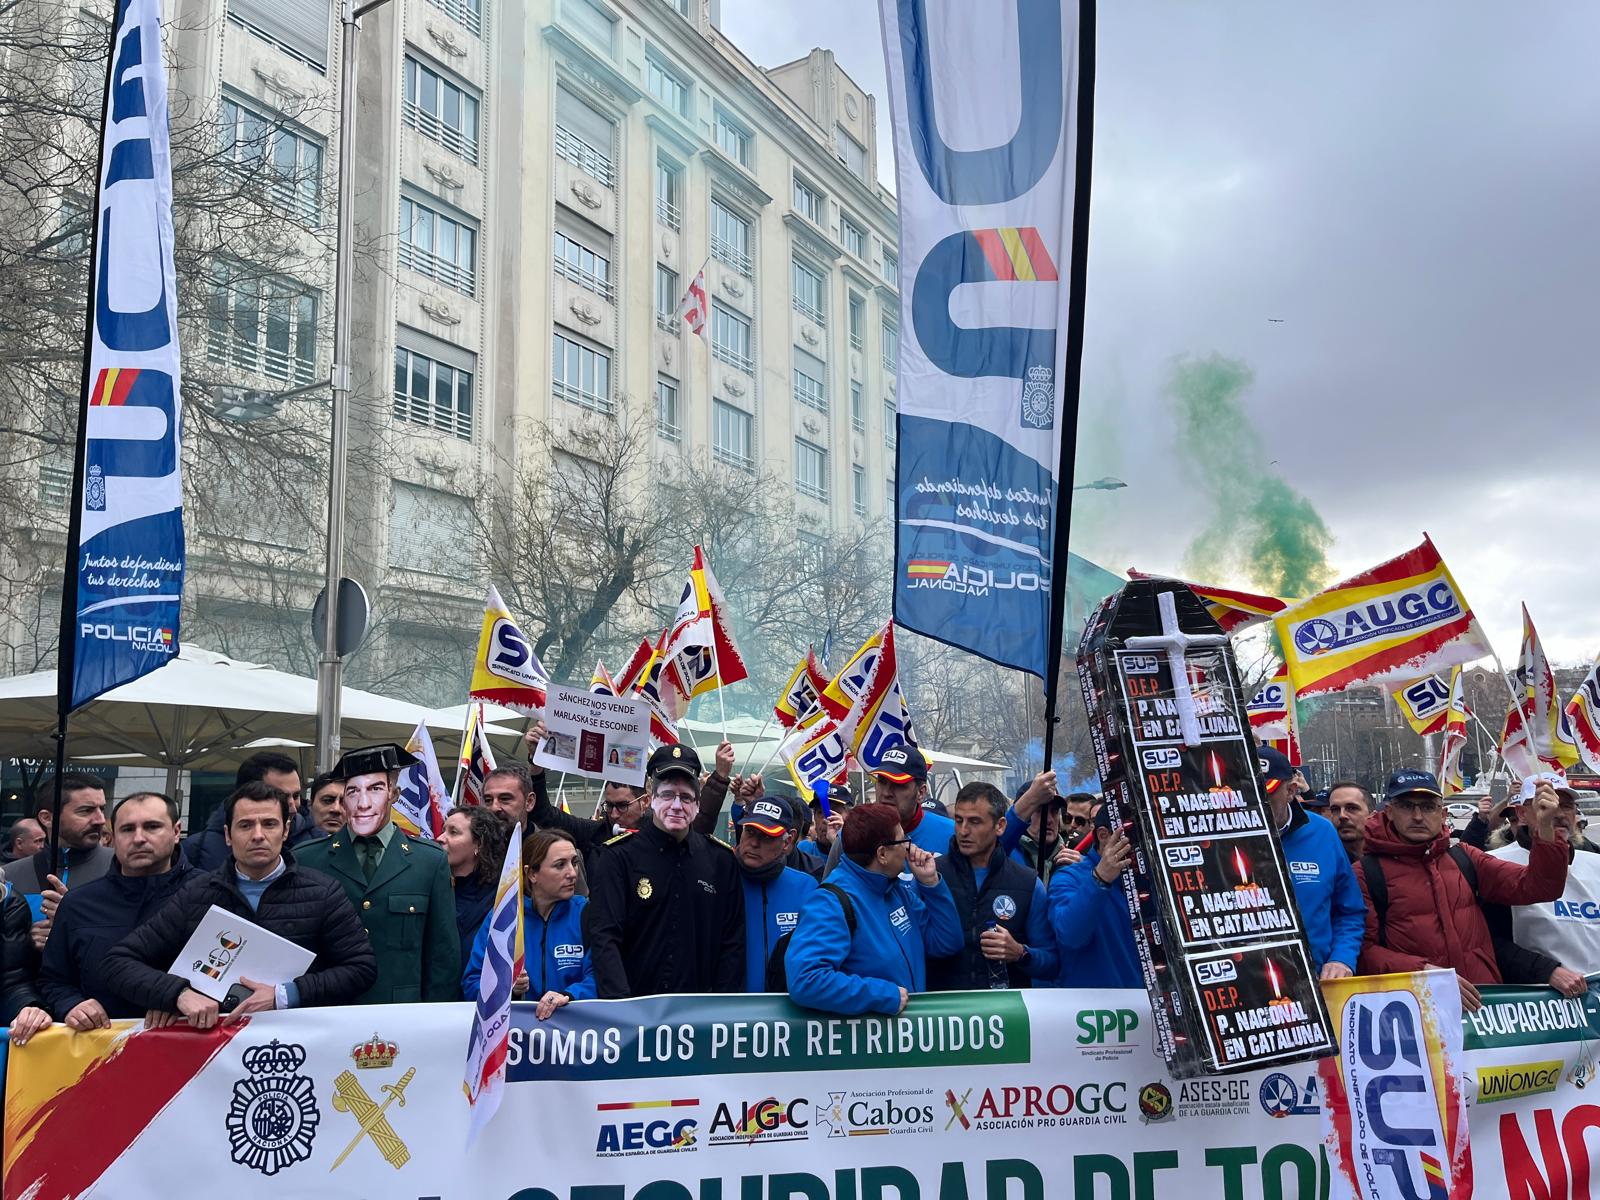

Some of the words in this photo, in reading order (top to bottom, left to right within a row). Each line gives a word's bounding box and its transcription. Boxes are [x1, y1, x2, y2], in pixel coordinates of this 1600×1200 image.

[81, 553, 118, 571] Juntos
[120, 555, 181, 578] defendiend
[87, 573, 105, 586] tus
[107, 573, 160, 588] derechos
[1344, 582, 1452, 637] AUGC
[1125, 657, 1156, 671] SUP
[558, 692, 590, 706] SÁNCHEZ
[590, 699, 607, 711] NOS
[607, 702, 635, 715] VENDE
[1407, 679, 1449, 712] SU
[1137, 699, 1153, 717] P.
[553, 709, 589, 725] MARLASKA
[588, 717, 598, 727] SE
[600, 719, 639, 733] ESCONDE
[1142, 719, 1163, 738] EN
[798, 732, 846, 783] SU
[884, 751, 906, 760] SUP
[1145, 750, 1179, 765] SUP
[756, 803, 780, 814] SUP
[1158, 796, 1175, 814] P.
[1176, 790, 1247, 812] NACIONAL
[1164, 816, 1185, 836] EN
[1167, 847, 1201, 862] SUP
[1291, 863, 1319, 872] SUP
[1183, 895, 1200, 915] P.
[1201, 887, 1275, 913] NACIONAL
[1553, 900, 1600, 919] AEG
[890, 908, 907, 924] SU
[1190, 918, 1211, 938] EN
[556, 945, 583, 956] SUP
[1198, 961, 1233, 979] SUP
[1076, 1008, 1139, 1044] SPP
[1216, 1013, 1235, 1035] P.
[1235, 1001, 1308, 1032] NACIONAL
[507, 1027, 620, 1065] SOMOS
[637, 1023, 695, 1062] LOS
[711, 1021, 790, 1059] PEOR
[807, 1014, 1004, 1056] RETRIBUIDOS
[1348, 1001, 1356, 1065] SINDICATO
[1224, 1037, 1247, 1060] EN
[887, 1088, 924, 1097] Profesional
[925, 1087, 934, 1095] de
[974, 1081, 1127, 1118] APROGC
[848, 1099, 934, 1127] Cabos
[1178, 1109, 1188, 1117] DE
[1190, 1109, 1199, 1117] LA
[1200, 1108, 1231, 1117] GUARDIA
[1233, 1107, 1251, 1115] CIVIL
[1350, 1069, 1367, 1139] UNIFICADO
[709, 1097, 809, 1134] AIGC
[976, 1117, 1034, 1130] ASOCIACIÓN
[1037, 1117, 1055, 1127] PRO
[1059, 1115, 1101, 1126] GUARDIA
[1103, 1114, 1127, 1124] CIVIL
[252, 1134, 293, 1148] NACIONAL
[596, 1119, 699, 1152] AEGC
[1360, 1142, 1369, 1160] DE
